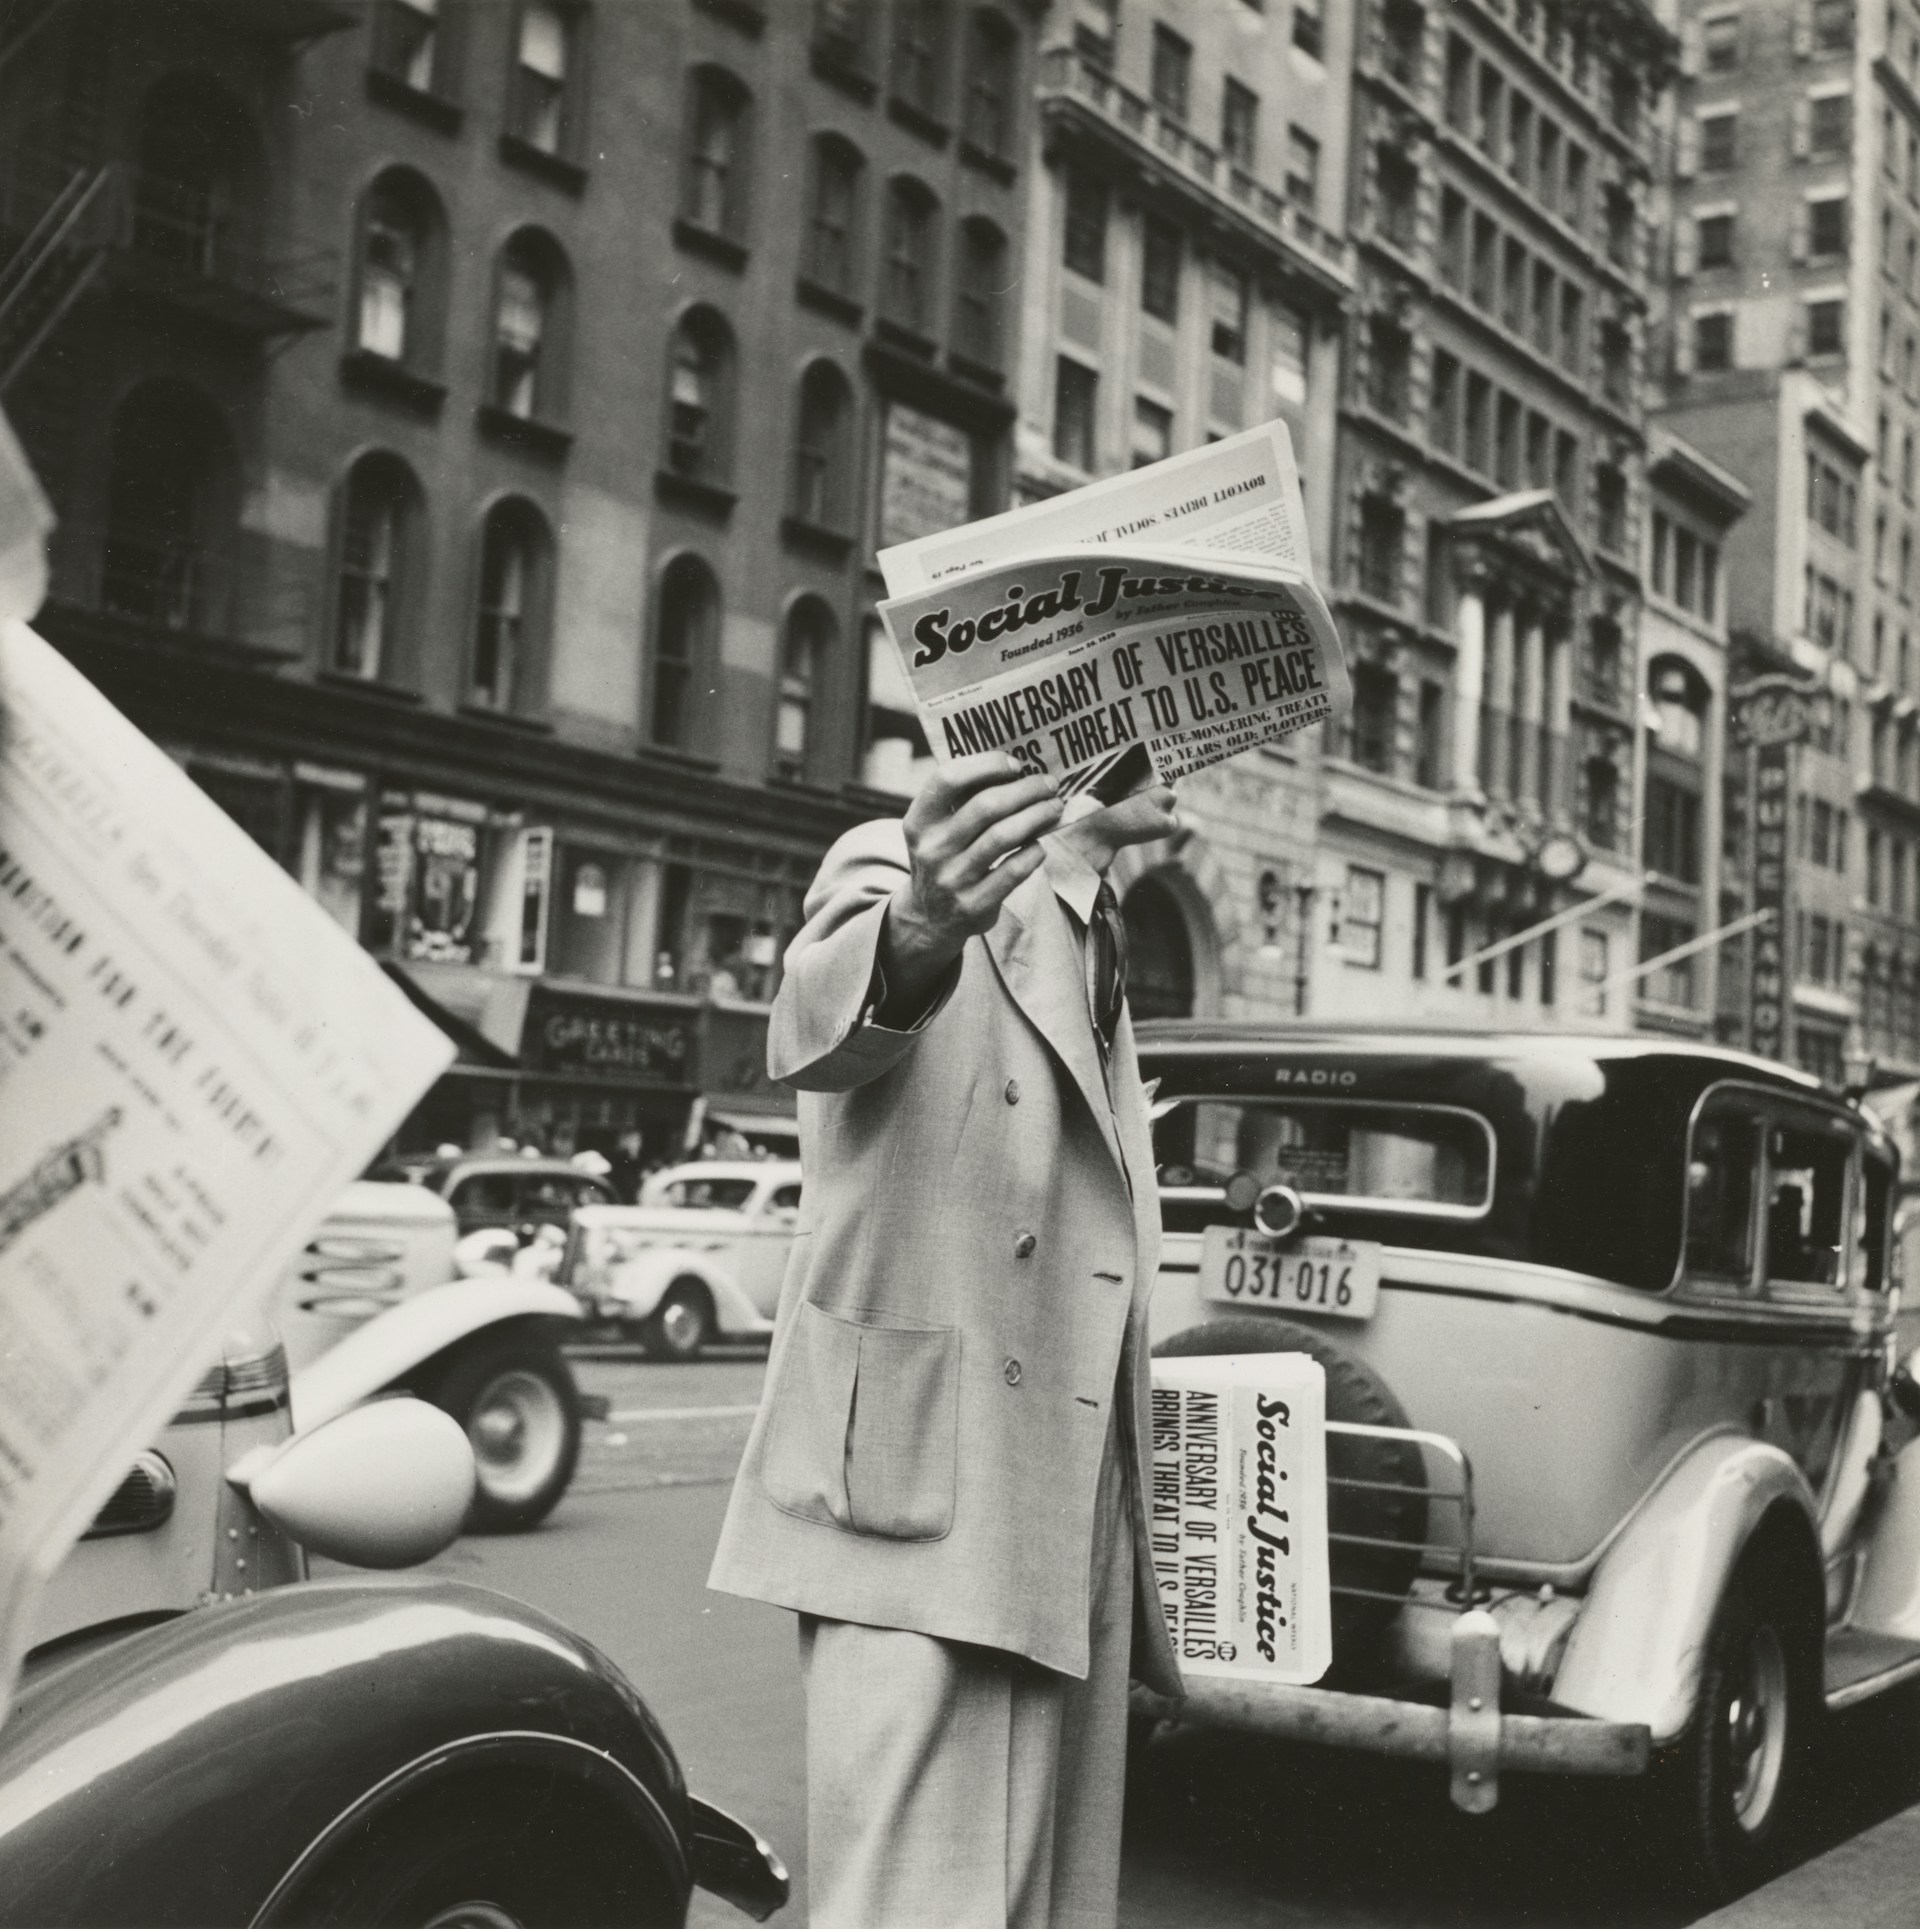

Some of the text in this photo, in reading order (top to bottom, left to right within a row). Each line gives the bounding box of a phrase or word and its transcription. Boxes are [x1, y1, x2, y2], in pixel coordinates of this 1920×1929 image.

[1163, 496, 1208, 519] DRIVES
[1213, 474, 1266, 504] BOYCOTT
[913, 568, 1283, 668] Social Justice
[1115, 609, 1131, 620] by
[1135, 601, 1180, 616] Father
[1000, 621, 1085, 662] Founded 1936
[941, 658, 1103, 759] ANNIVERSARY
[1112, 641, 1144, 690] OF
[1155, 620, 1312, 676] VERSAILLES
[1049, 696, 1139, 770] THREAT
[1141, 685, 1180, 731] TO
[1183, 671, 1239, 721] U.S.
[1240, 648, 1322, 706] PEACE
[1150, 710, 1272, 752] HATE-MONGERING
[1275, 692, 1330, 718] TREATY
[1155, 754, 1173, 769] 20
[1176, 740, 1222, 761] YEARS
[1263, 706, 1332, 736] PLOTTERS
[546, 1014, 685, 1060] GREETING
[1275, 1068, 1357, 1086] RADIO
[1152, 1389, 1180, 1452] BRINGS
[1239, 1448, 1247, 1488] Founded
[1153, 1461, 1180, 1525] THREAT
[1152, 1533, 1179, 1554] TO
[1184, 1390, 1218, 1660] ANNIVERSARY OF VERSAILLES
[1247, 1392, 1290, 1663] Social Justice
[1238, 1549, 1247, 1577] Father
[1237, 1582, 1247, 1623] Coughlin
